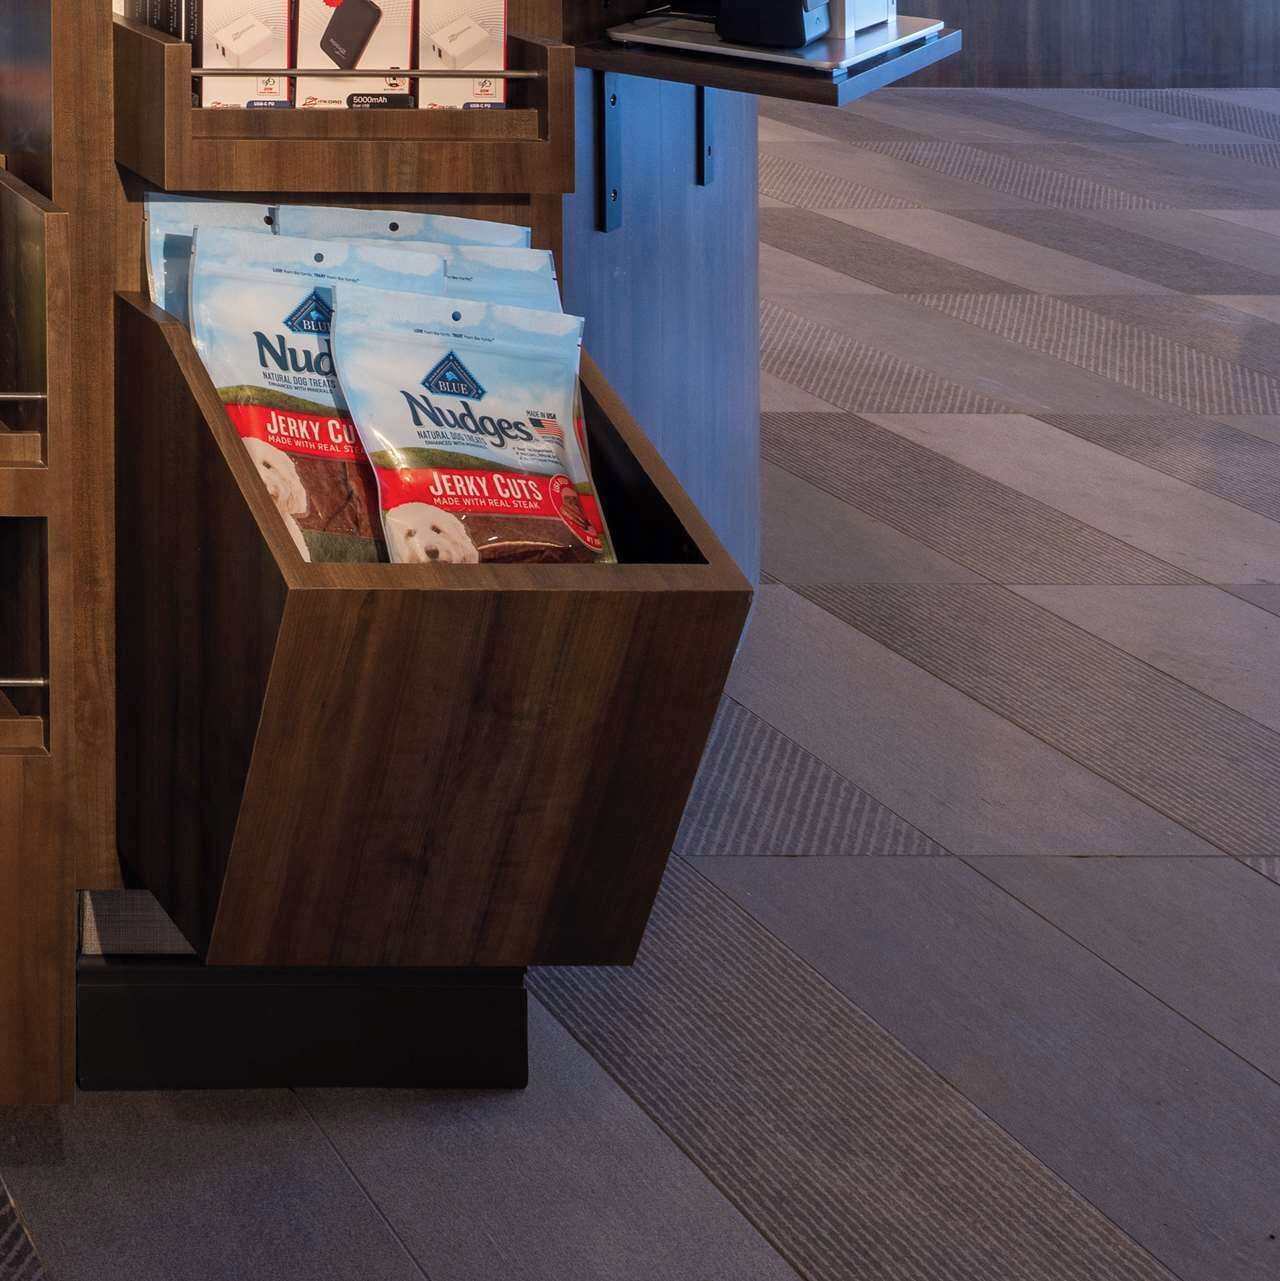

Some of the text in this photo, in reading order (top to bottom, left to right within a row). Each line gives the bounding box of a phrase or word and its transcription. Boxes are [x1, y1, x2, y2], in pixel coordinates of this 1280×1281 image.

[438, 381, 469, 395] BLUE
[267, 411, 321, 441] JERKY
[400, 390, 534, 448] Nudges
[268, 434, 342, 453] MADE WITH REAL
[430, 471, 543, 501] JERKY CUTS
[433, 497, 541, 510] MADE WITH REAL STEAK
